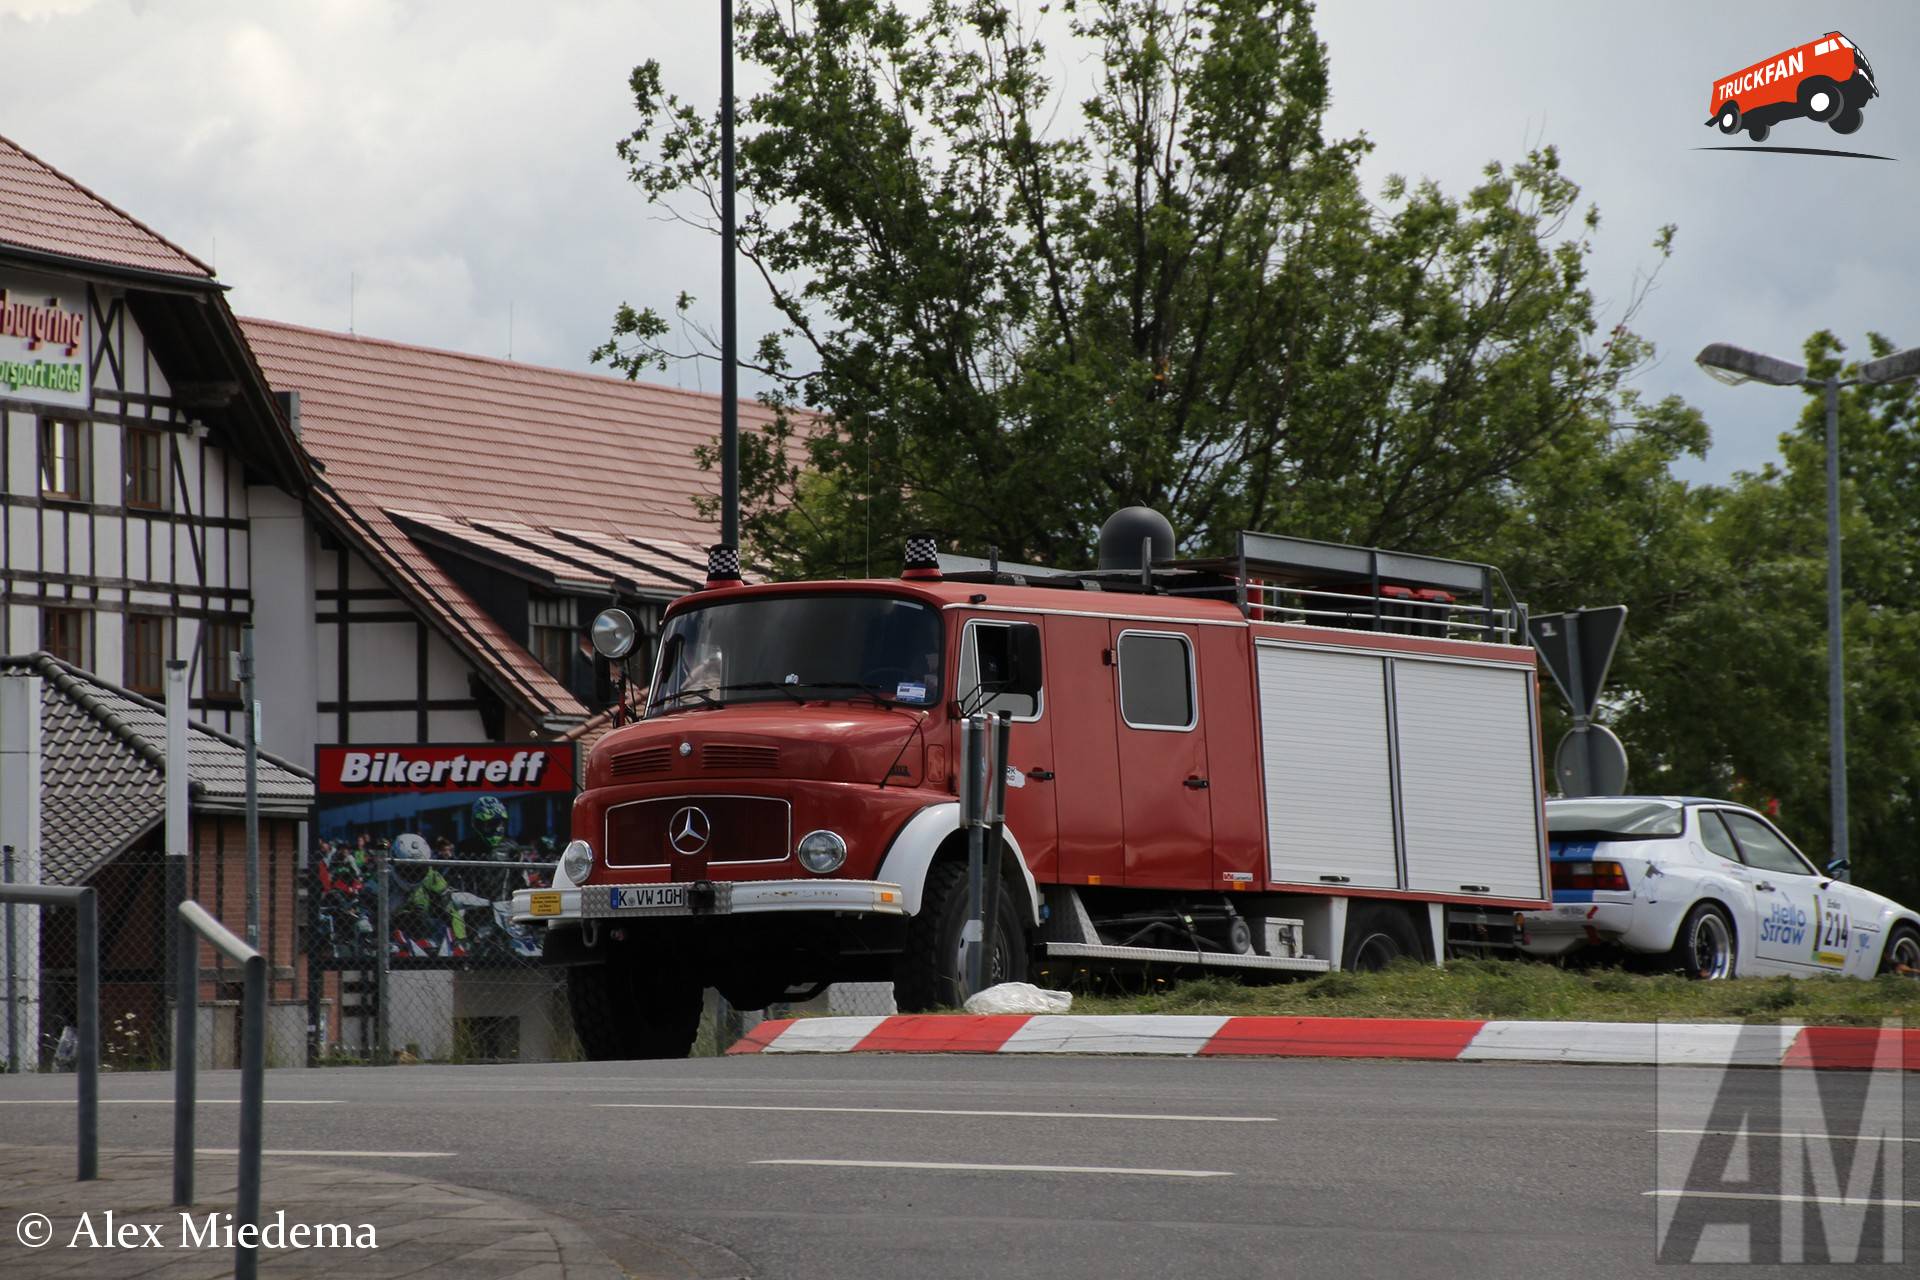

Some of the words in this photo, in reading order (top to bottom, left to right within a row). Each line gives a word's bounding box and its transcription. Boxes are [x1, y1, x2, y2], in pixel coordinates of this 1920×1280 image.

[47, 363, 82, 393] Hotel
[340, 751, 547, 785] Bikertreff
[618, 890, 628, 906] K
[636, 889, 654, 906] VW
[656, 888, 682, 905] 10H
[1760, 910, 1806, 946] Straw
[1771, 902, 1806, 928] Hello
[1824, 910, 1849, 949] 214
